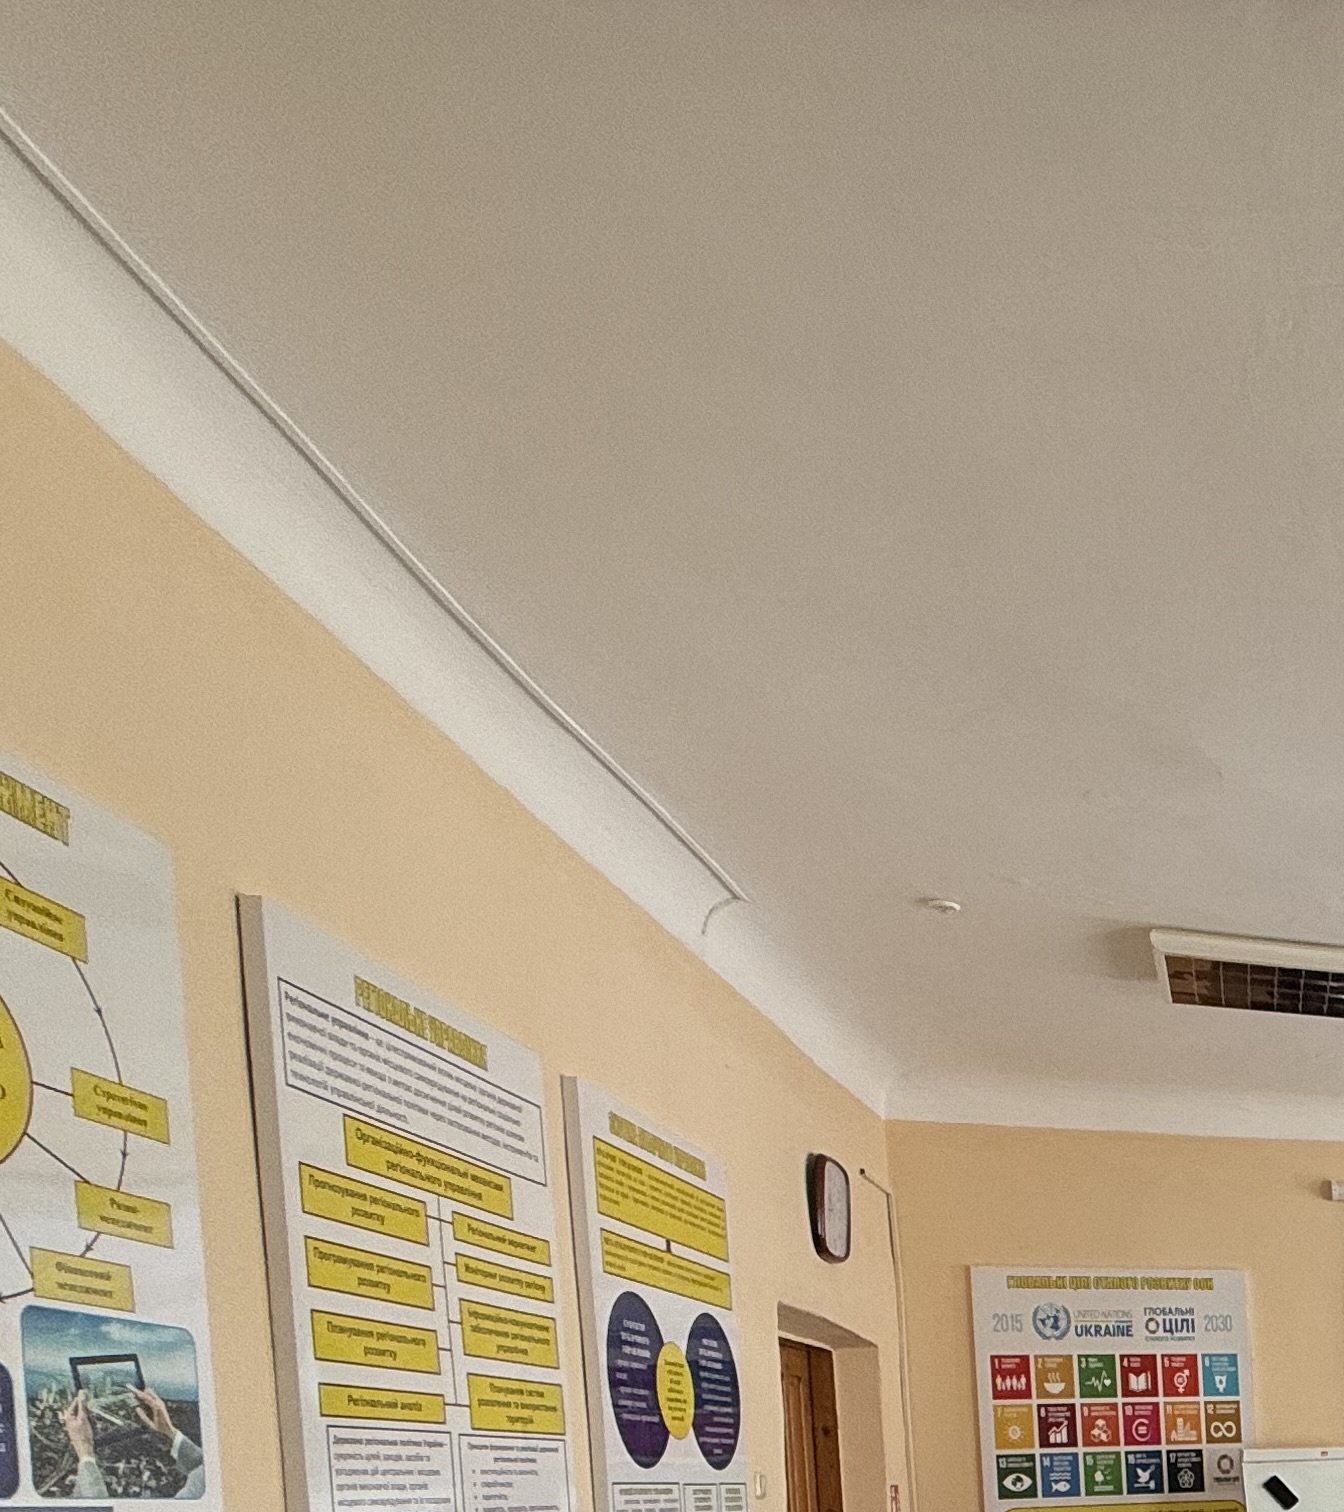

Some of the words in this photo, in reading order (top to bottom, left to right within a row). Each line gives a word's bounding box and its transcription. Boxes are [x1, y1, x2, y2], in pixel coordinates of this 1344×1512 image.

[1144, 1307, 1195, 1317] ГЛОБАЛЬНІ
[992, 1313, 1023, 1333] 2015
[1074, 1324, 1133, 1337] UKRAINE
[1163, 1318, 1196, 1335] ЦІЛІ
[1204, 1314, 1233, 1333] 2030
